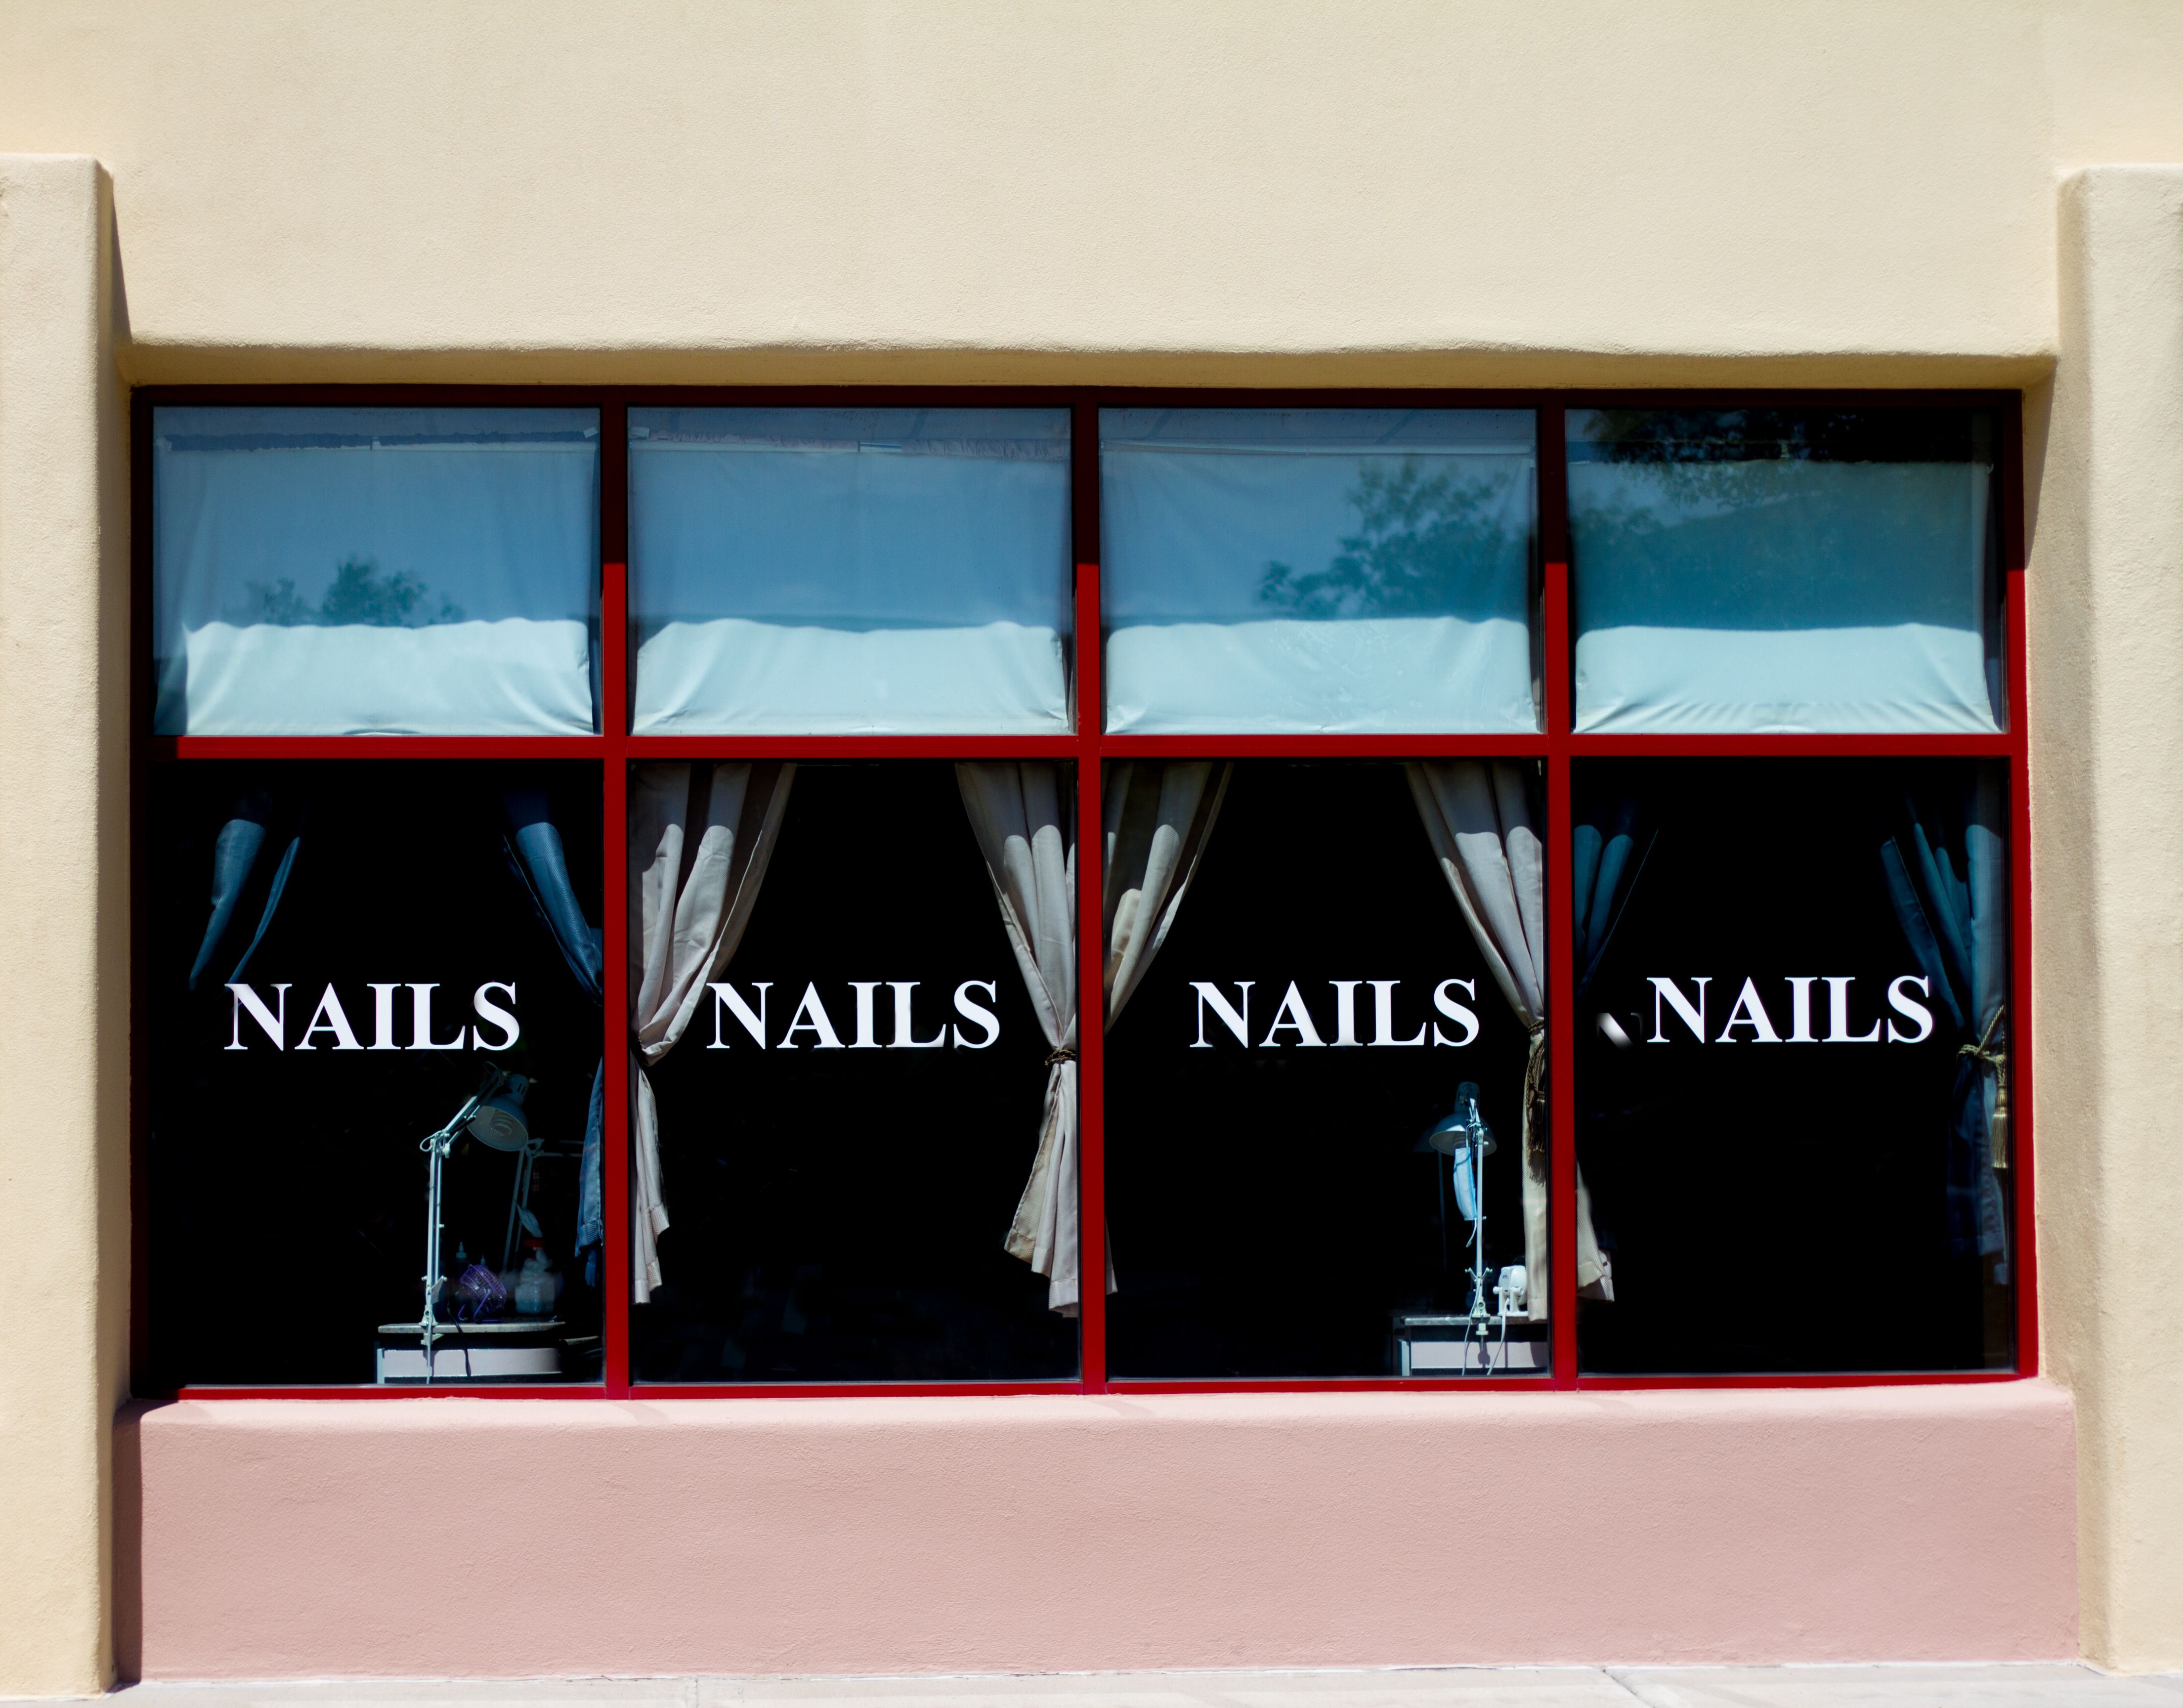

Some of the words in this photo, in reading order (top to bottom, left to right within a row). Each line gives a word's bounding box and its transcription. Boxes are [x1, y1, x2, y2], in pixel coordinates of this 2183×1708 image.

[224, 982, 519, 1051] NAILS
[706, 981, 1000, 1050] NAILS
[1189, 979, 1479, 1048] NAILS
[1646, 976, 1933, 1043] NAILS
